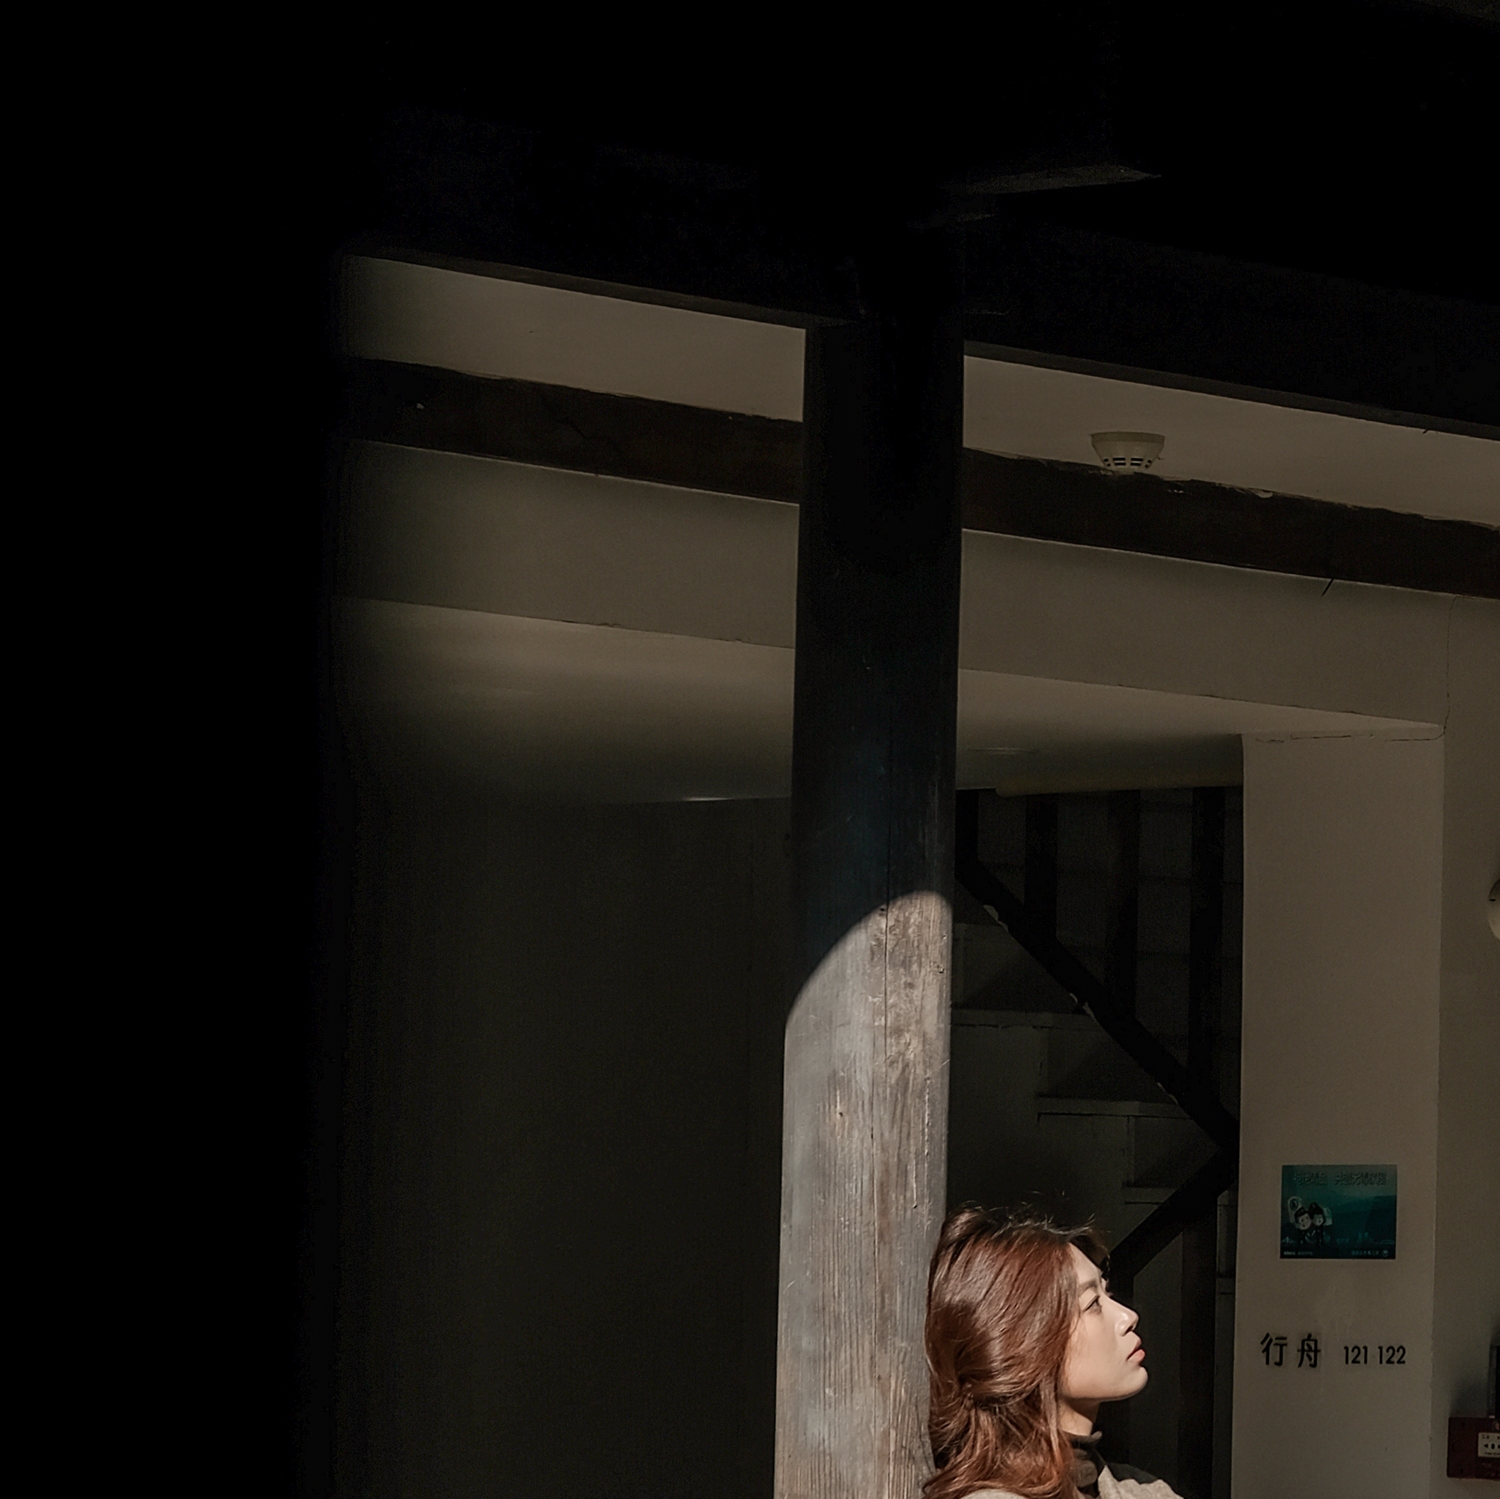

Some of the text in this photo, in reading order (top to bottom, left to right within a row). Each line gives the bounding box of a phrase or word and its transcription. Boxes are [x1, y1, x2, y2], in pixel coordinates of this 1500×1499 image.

[1259, 1332, 1407, 1369] 行舟 121 122
